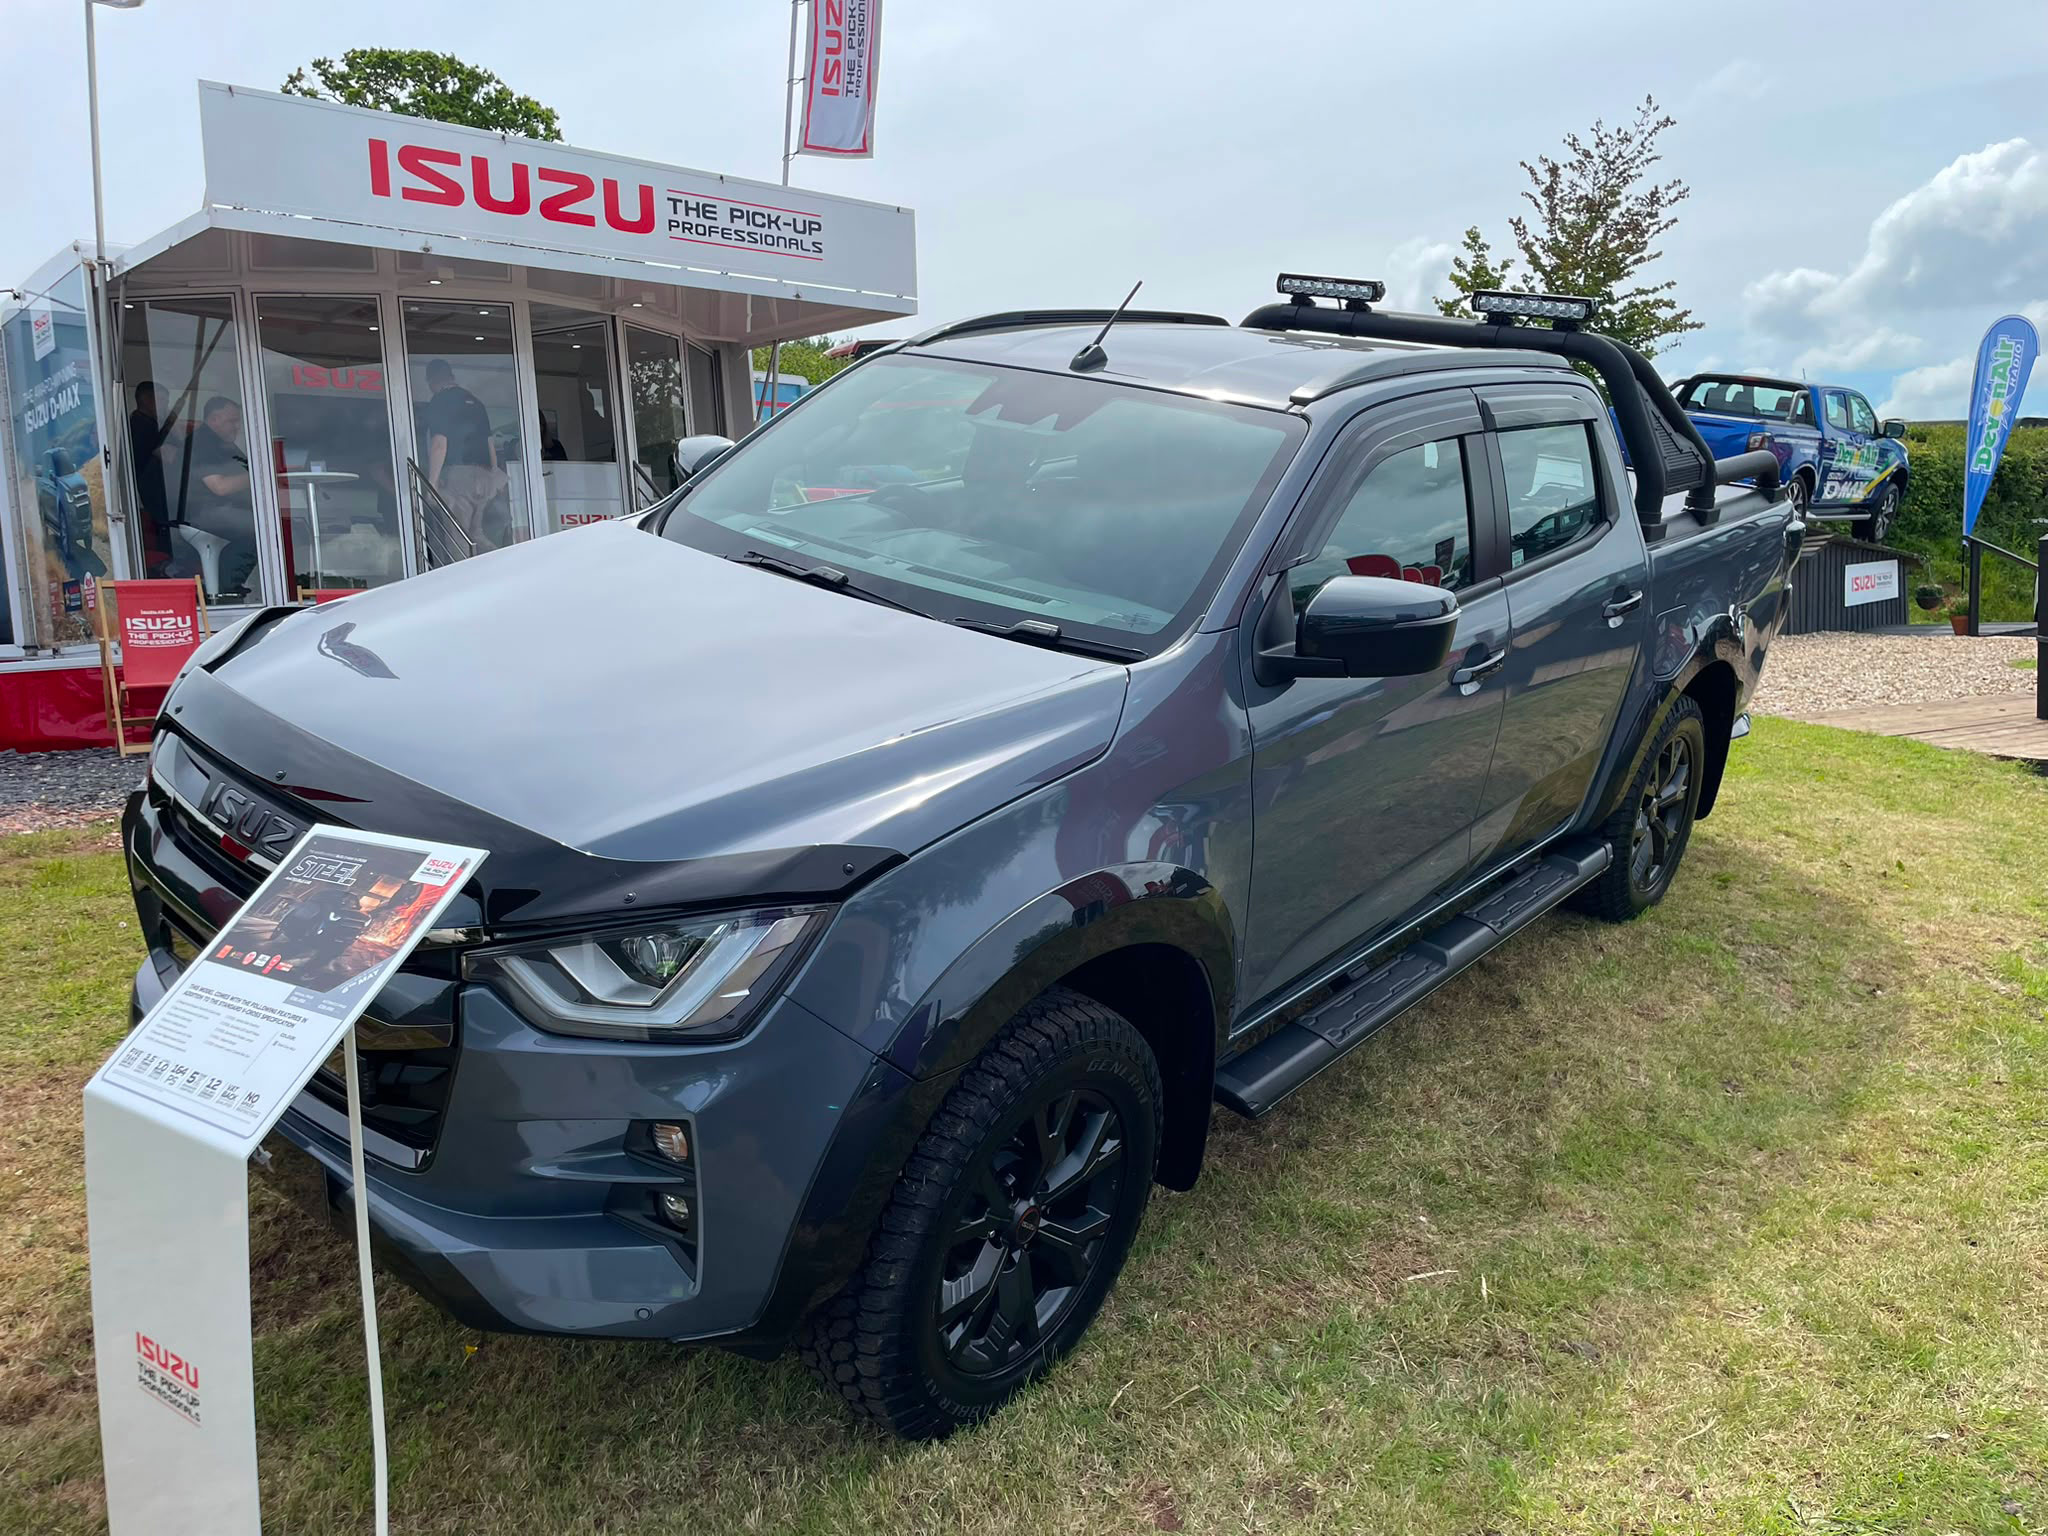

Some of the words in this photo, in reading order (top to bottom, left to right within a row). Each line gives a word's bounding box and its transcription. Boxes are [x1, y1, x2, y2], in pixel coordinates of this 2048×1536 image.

[855, 0, 866, 98] PROFESSION
[845, 59, 857, 97] THE
[368, 138, 655, 234] ISUZU
[667, 197, 718, 221] THE
[729, 207, 822, 236] PICK-UP
[668, 219, 823, 254] PROFESSIONALS
[292, 365, 385, 391] ISUZ
[2010, 343, 2022, 387] RADIO
[24, 401, 49, 434] ISUZU
[50, 382, 80, 420] D-MAX
[1971, 336, 2016, 474] DevonAir
[1852, 574, 1876, 592] ISUZU
[126, 616, 192, 630] ISUZU
[152, 630, 193, 639] PICK-UP
[206, 782, 308, 859] ISUZ
[289, 854, 363, 887] STEEL
[426, 859, 457, 869] ISUZU
[171, 1064, 189, 1075] 164
[186, 1071, 199, 1083] 5
[205, 1078, 223, 1090] 12
[244, 1092, 261, 1104] NO
[136, 1331, 198, 1389] ISUZU
